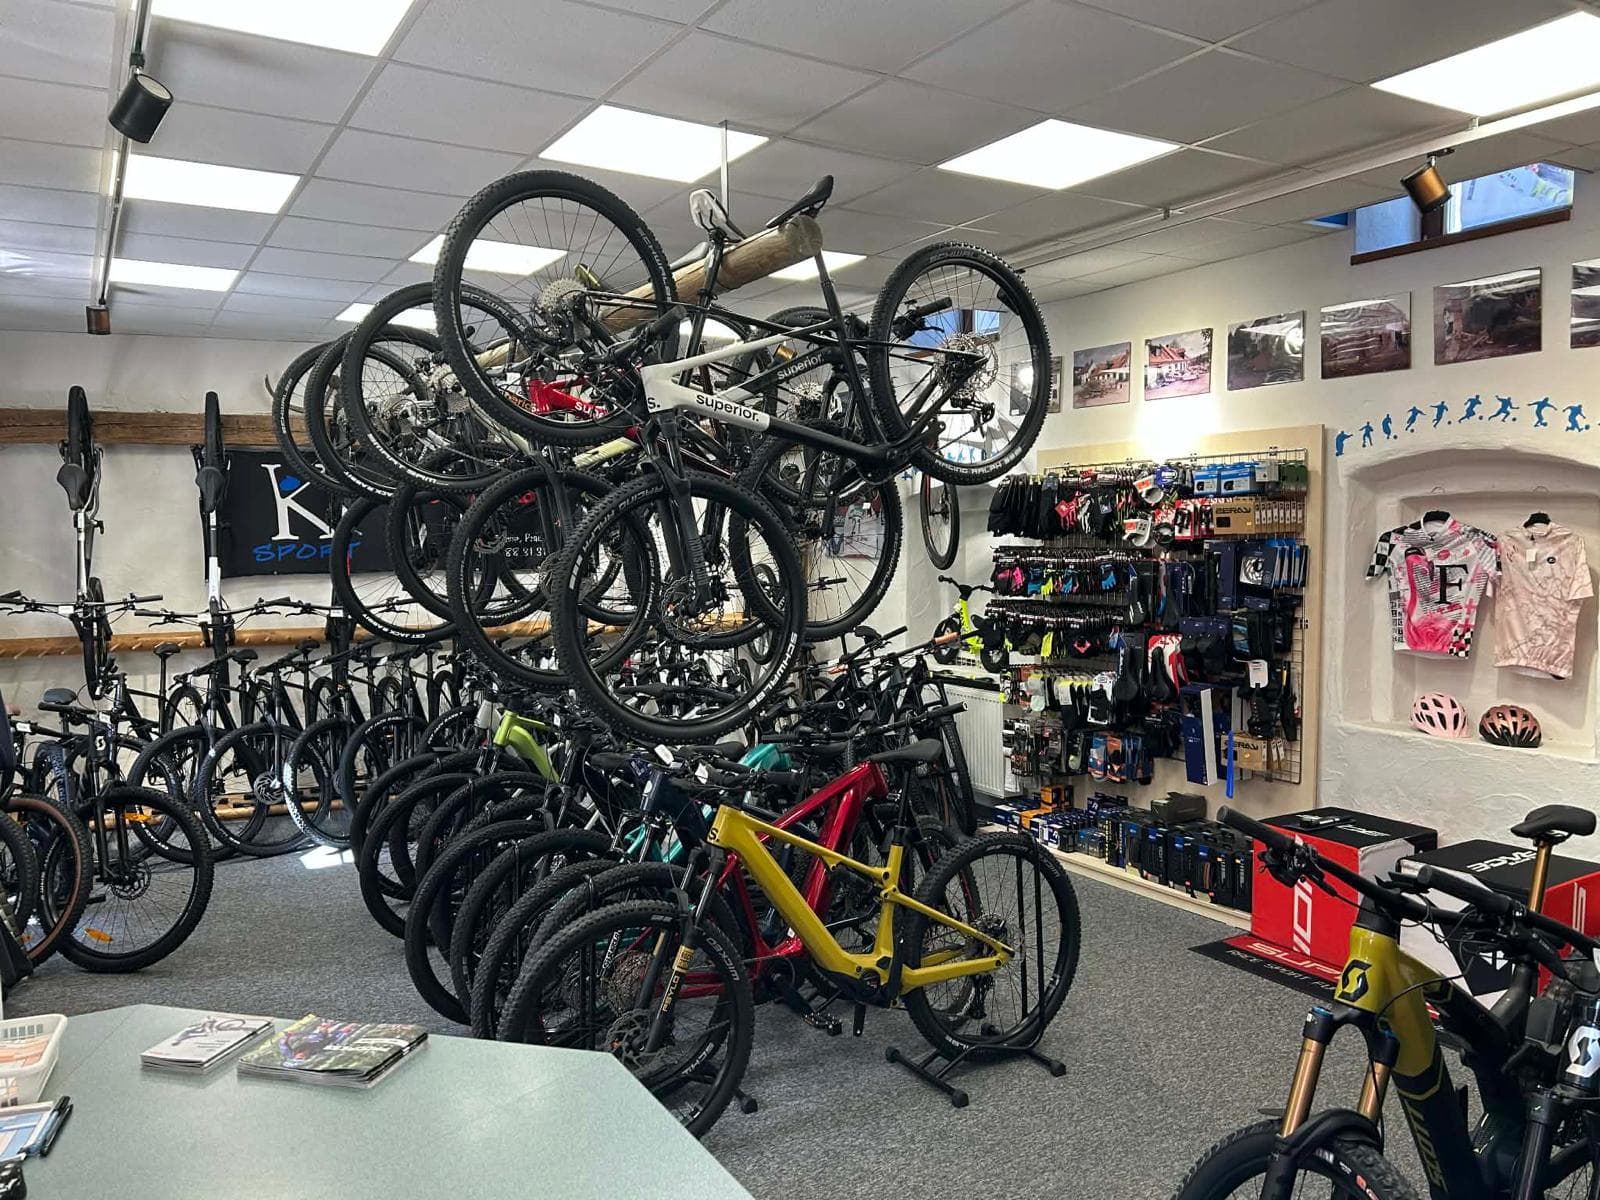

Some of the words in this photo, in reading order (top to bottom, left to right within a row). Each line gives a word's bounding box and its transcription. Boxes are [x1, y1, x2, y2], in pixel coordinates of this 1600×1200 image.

[777, 353, 824, 380] superior.
[647, 397, 661, 410] S.
[696, 393, 760, 423] superior.
[1434, 564, 1469, 605] F
[747, 631, 798, 711] SCHWALBE
[708, 827, 720, 842] S.
[1246, 942, 1341, 979] SUP
[661, 975, 681, 1012] PSYLO
[1403, 1098, 1448, 1193] SCOTT
